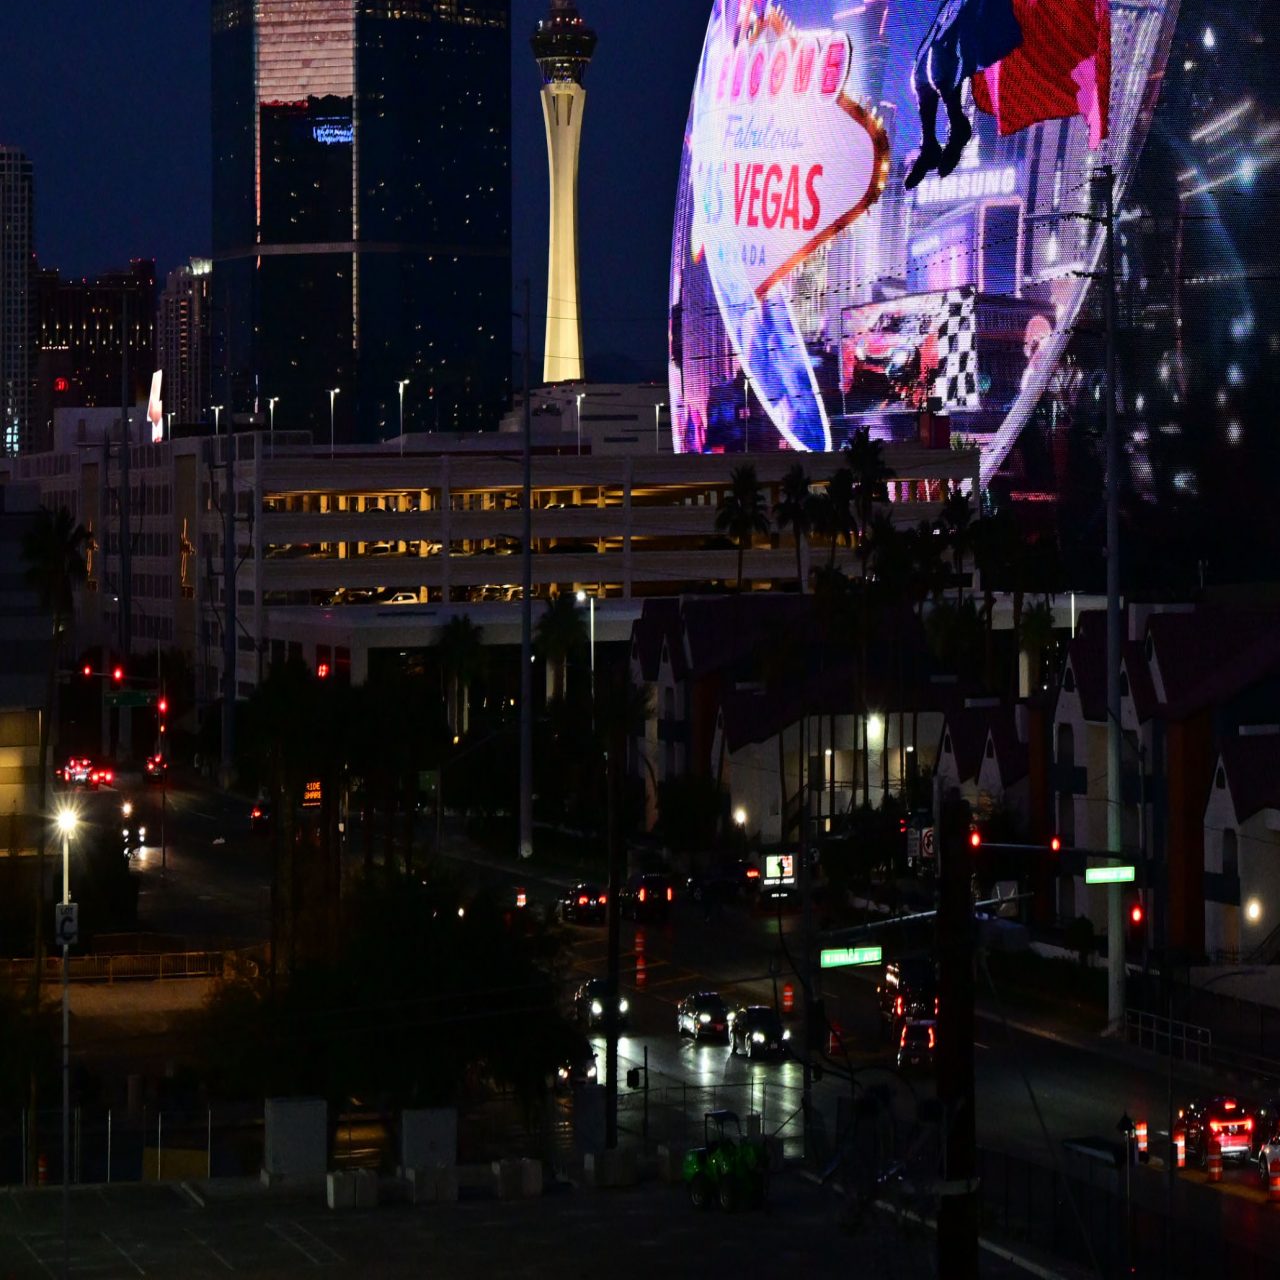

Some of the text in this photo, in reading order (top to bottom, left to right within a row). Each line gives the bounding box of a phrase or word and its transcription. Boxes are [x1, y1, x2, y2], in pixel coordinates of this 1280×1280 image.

[734, 163, 823, 231] VEGAS
[917, 166, 1016, 205] SAMSUNG
[60, 916, 74, 940] C
